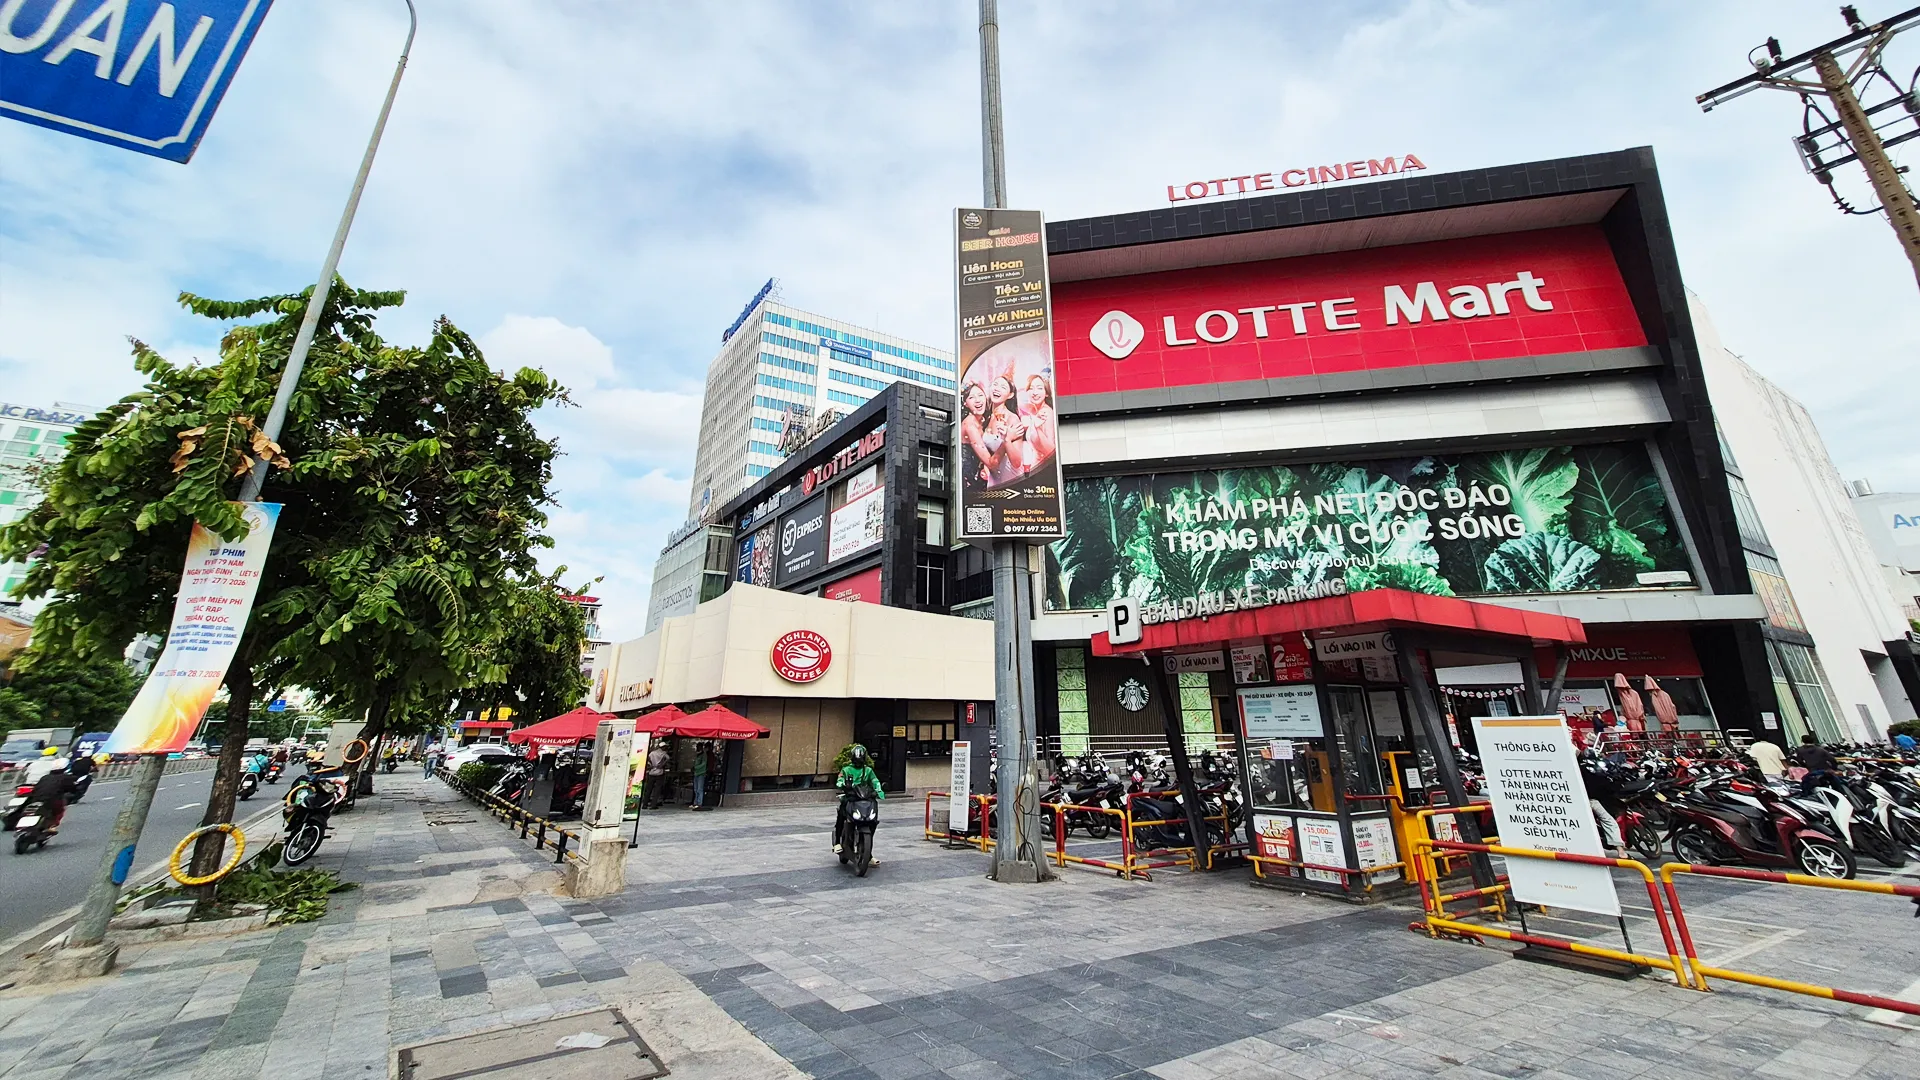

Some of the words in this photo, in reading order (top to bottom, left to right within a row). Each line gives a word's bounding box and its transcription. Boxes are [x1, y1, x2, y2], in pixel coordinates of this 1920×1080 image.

[1167, 172, 1274, 201] LOTTE
[1281, 154, 1427, 187] CINEMA
[962, 238, 993, 252] BEER
[995, 232, 1039, 248] HOUSE
[963, 263, 988, 274] Liên
[990, 260, 1024, 271] Hoan
[1022, 280, 1042, 292] Vui
[1163, 297, 1361, 347] LOTTE
[1383, 271, 1554, 325] Mart
[963, 316, 986, 328] Hát
[988, 312, 1008, 323] Với
[1010, 308, 1044, 320] Nhau
[816, 448, 860, 485] LOTTE
[857, 430, 886, 460] Mar
[1035, 485, 1055, 494] 30m
[1165, 496, 1248, 525] KHÁM
[1251, 491, 1311, 520] PHÁ
[1314, 488, 1367, 517] NÉT
[1375, 484, 1440, 517] ĐỘC
[1443, 479, 1511, 509] ĐÁO
[1003, 508, 1026, 516] Booking
[796, 515, 823, 540] EXPRESS
[1162, 528, 1259, 553] TRONG
[1312, 524, 1345, 551] VỊ
[1349, 516, 1436, 546] CUỘC
[1438, 510, 1527, 541] SỐNG
[222, 548, 246, 557] PHIM
[1249, 557, 1307, 571] Discover
[1327, 552, 1371, 569] Joyful
[1147, 594, 1180, 625] BÃI
[1182, 590, 1226, 623] ĐẬU
[1229, 583, 1265, 611] XE
[1266, 577, 1348, 605] PARKING
[1113, 604, 1130, 637] P
[776, 631, 830, 654] HIGHLANDS
[1323, 641, 1340, 654] LỐI
[1340, 640, 1360, 652] VÀO
[1181, 656, 1193, 667] LỐI
[1193, 656, 1207, 666] VÀO
[1232, 653, 1253, 662] ONLINE
[1273, 644, 1287, 669] 2
[1570, 647, 1628, 662] MIXUE
[781, 666, 822, 680] COFFEE
[1560, 694, 1581, 702] -DAY
[1494, 741, 1531, 753] THÔNG
[1533, 741, 1556, 753] BÁO
[1500, 769, 1531, 778] LOTTE
[1533, 770, 1563, 779] MART
[1500, 779, 1522, 789] TÂN
[1523, 779, 1549, 791] BÌNH
[1504, 791, 1534, 803] NHẬN
[1536, 791, 1555, 803] GIỮ
[1557, 795, 1573, 804] XE
[1515, 802, 1553, 815] KHÁCH
[1554, 806, 1567, 815] ĐI
[1509, 815, 1534, 825] MUA
[1534, 815, 1560, 827] SẮM
[1561, 818, 1580, 830] TẠI
[1303, 826, 1329, 835] +15,000
[1523, 826, 1548, 837] SIÊU
[1549, 829, 1572, 841] THỊ.
